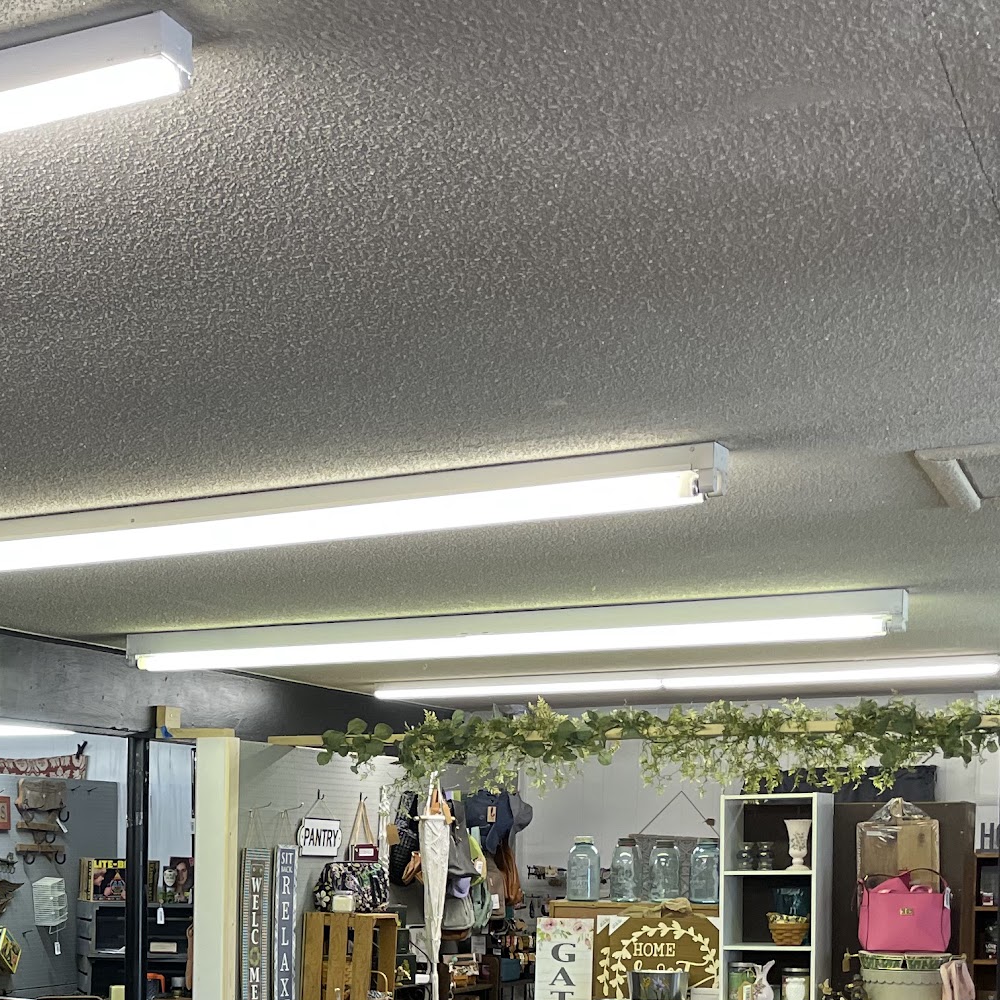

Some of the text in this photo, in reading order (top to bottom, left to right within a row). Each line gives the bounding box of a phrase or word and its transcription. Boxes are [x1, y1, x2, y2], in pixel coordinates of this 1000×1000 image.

[303, 828, 339, 847] PANTRY
[93, 860, 126, 869] LITE-B
[281, 852, 294, 864] SIT
[249, 877, 262, 1000] WELCOME
[279, 876, 291, 997] RELAX
[632, 942, 676, 957] HOME
